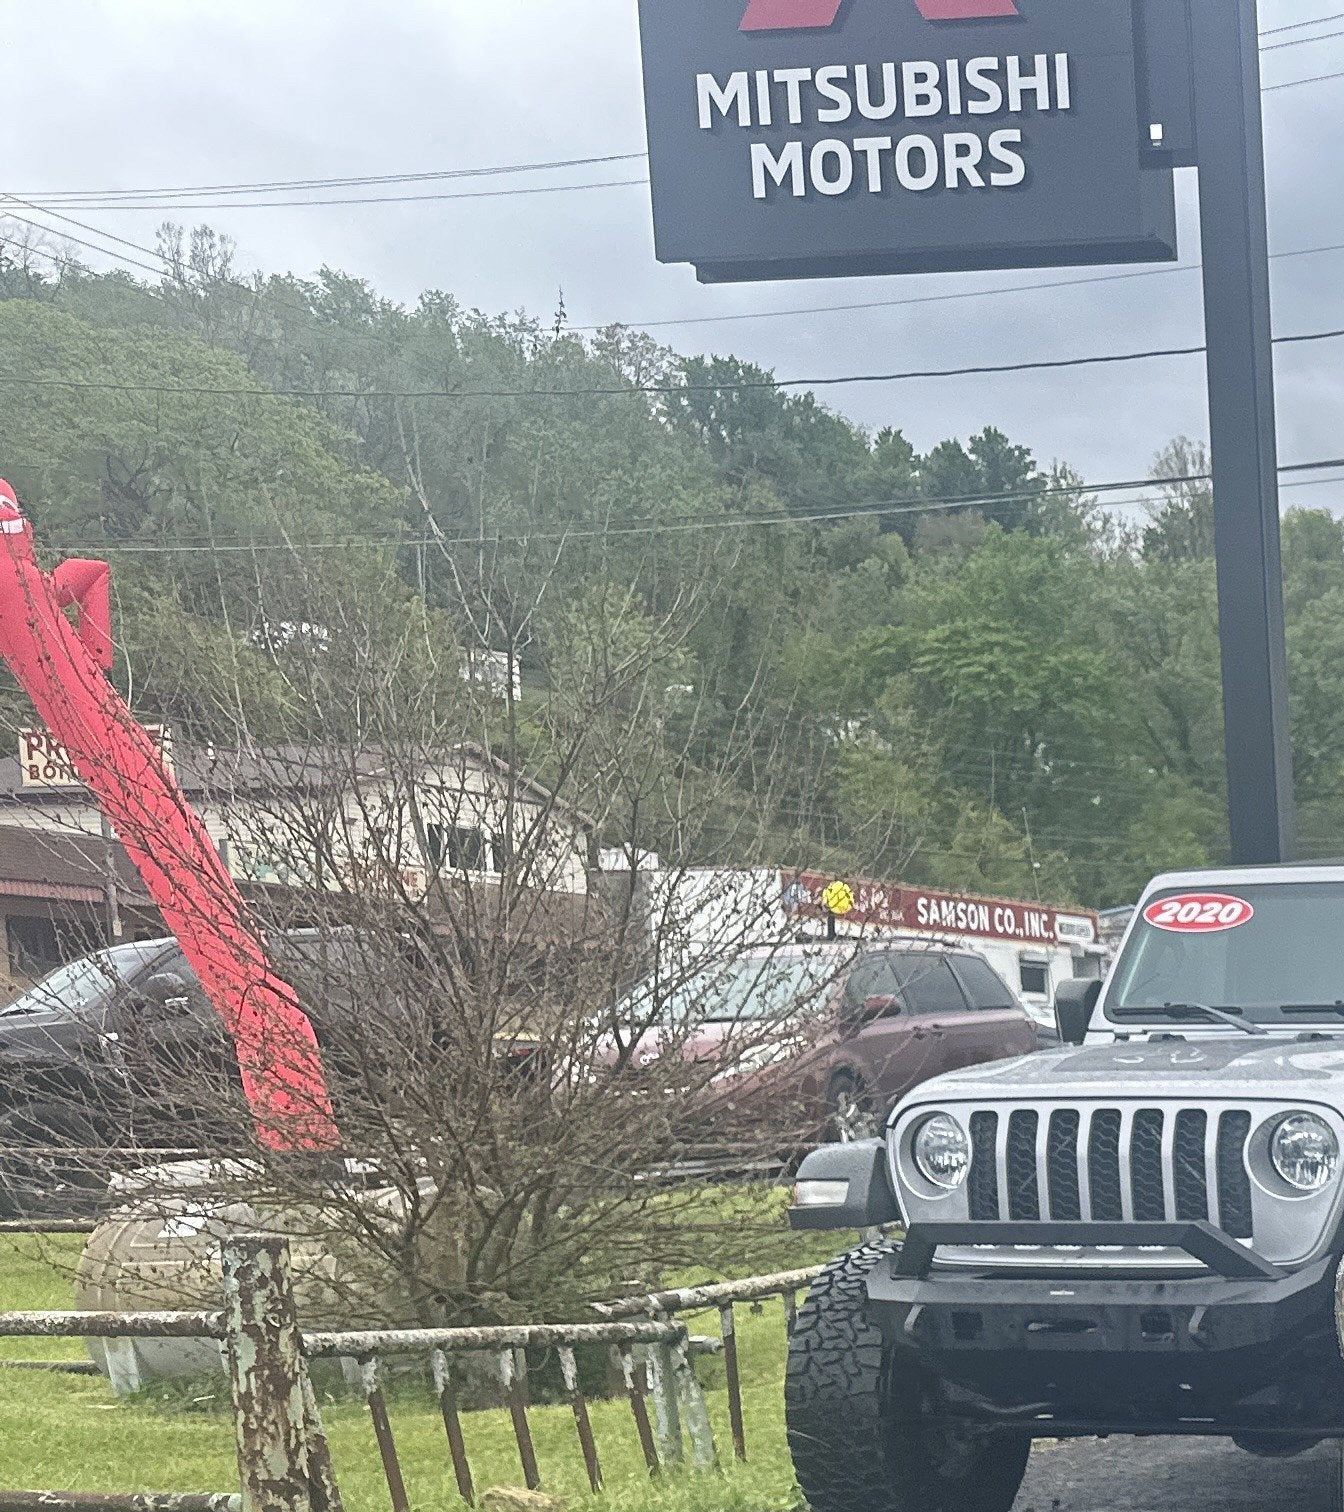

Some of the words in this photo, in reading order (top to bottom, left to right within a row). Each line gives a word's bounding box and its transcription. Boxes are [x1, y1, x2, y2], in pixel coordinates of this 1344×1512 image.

[696, 53, 1071, 129] MITSUBISHI
[750, 129, 1026, 199] MOTORS
[917, 897, 990, 932] SAMSON
[1153, 901, 1243, 924] 2020
